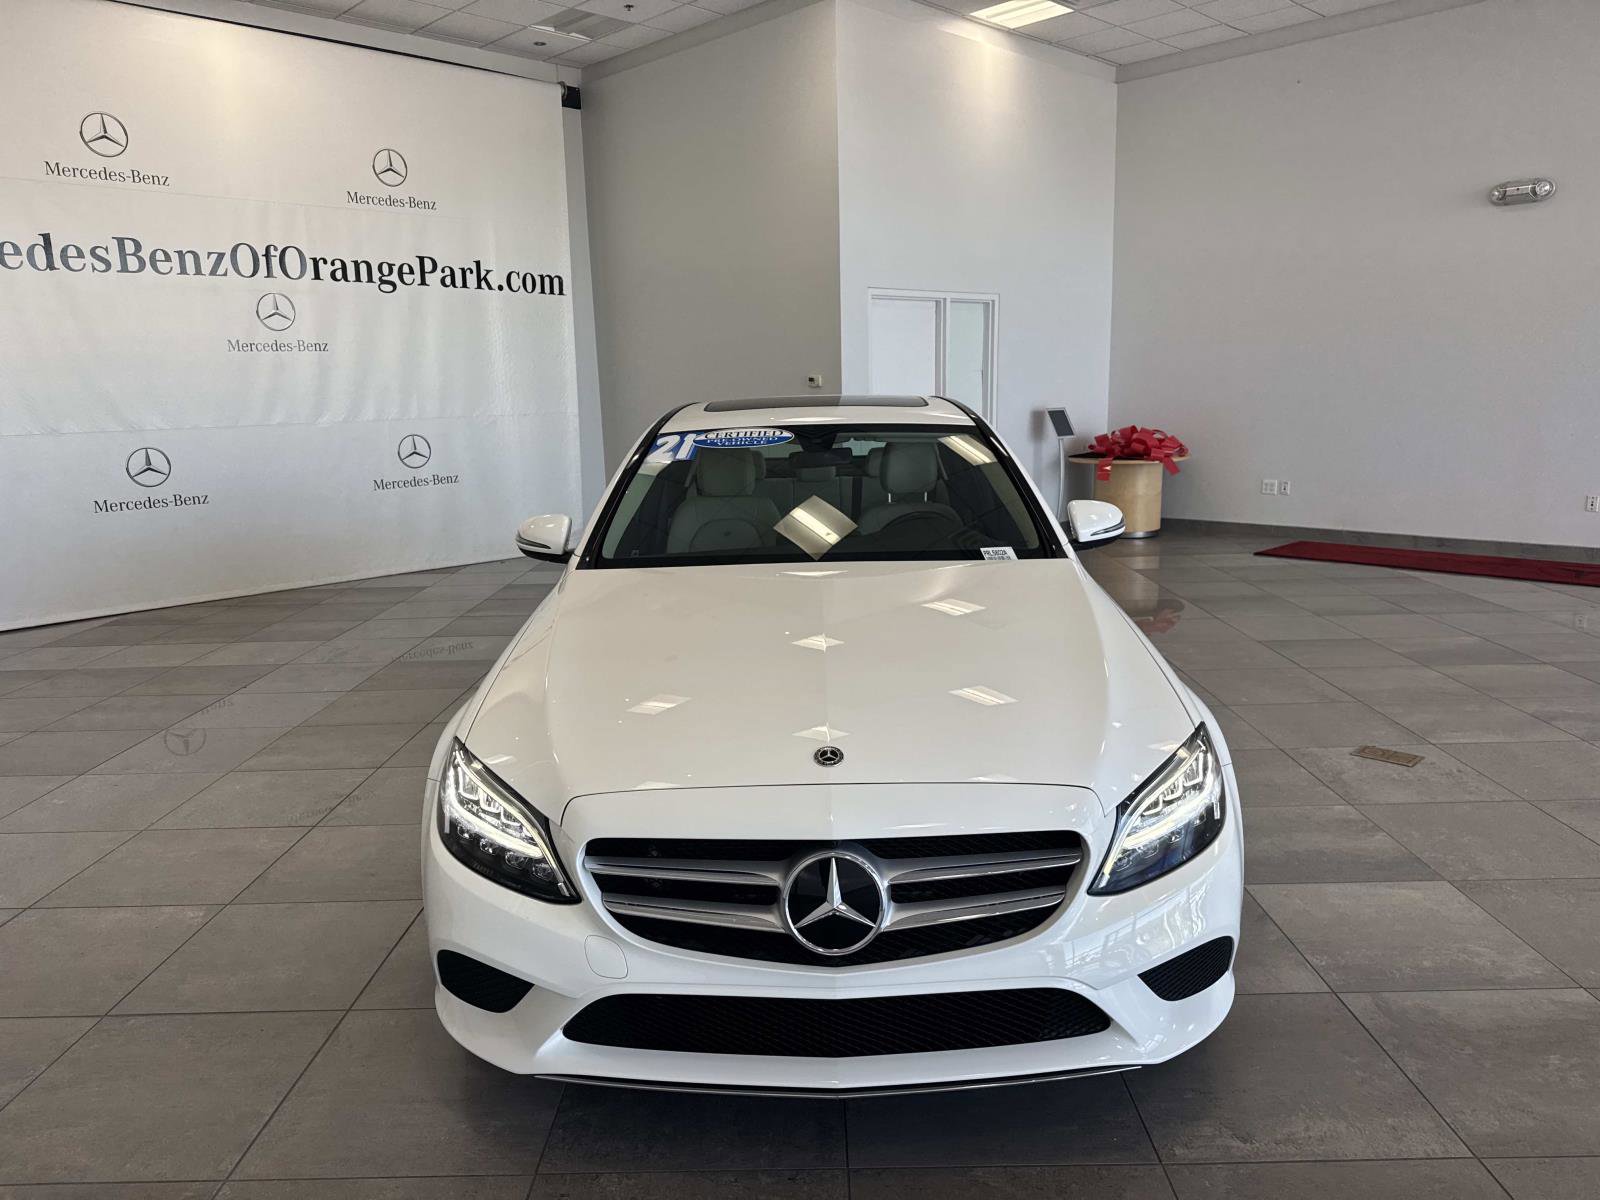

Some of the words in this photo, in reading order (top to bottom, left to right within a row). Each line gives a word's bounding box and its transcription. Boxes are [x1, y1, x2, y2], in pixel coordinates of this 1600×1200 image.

[44, 161, 170, 187] Mercedes-Benz
[346, 190, 437, 211] Mercedes-Benz
[0, 232, 566, 297] edesBenzOfOrangePark.com
[226, 338, 329, 353] Mercedes-Benz
[704, 430, 784, 439] CERTIFIED
[645, 433, 697, 463] 21
[372, 473, 460, 492] Mercedes-Benz
[93, 493, 210, 514] Mercedes-Benz
